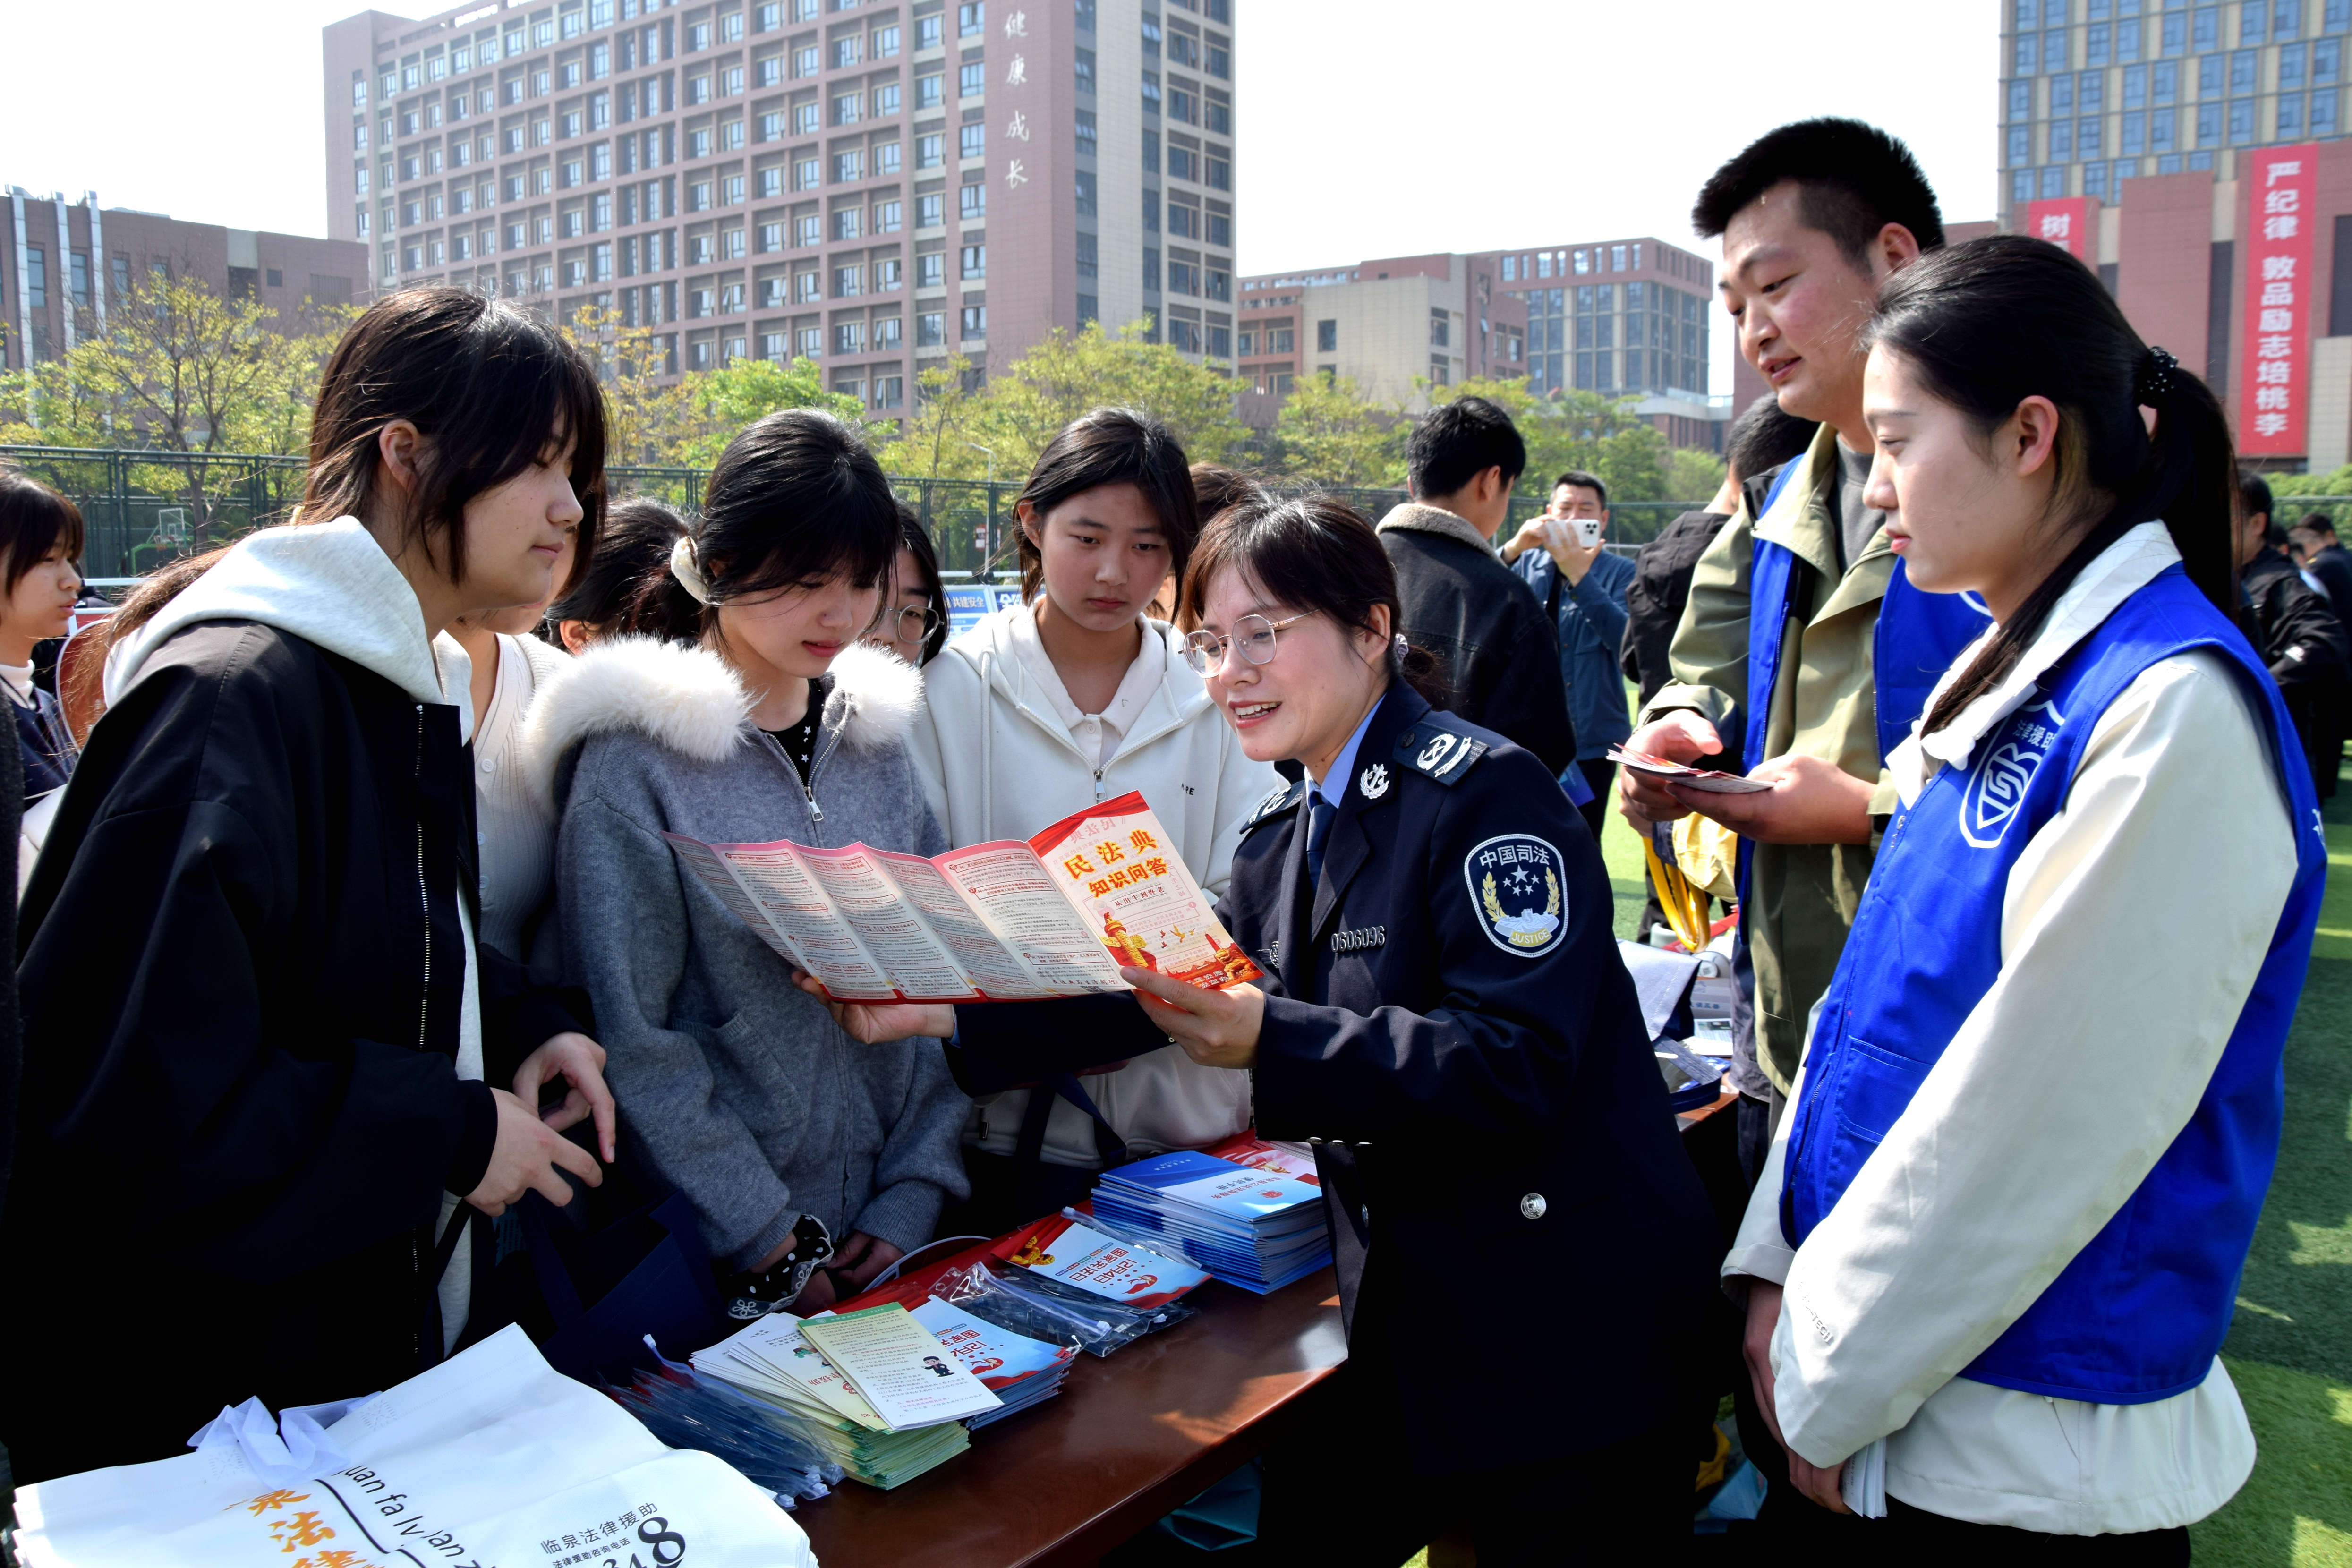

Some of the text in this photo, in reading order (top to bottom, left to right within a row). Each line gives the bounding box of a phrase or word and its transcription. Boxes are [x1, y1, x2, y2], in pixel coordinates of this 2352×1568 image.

[1004, 9, 1030, 189] 健康成长
[2254, 161, 2302, 437] 严纪律 敦品励志培桃李
[953, 596, 985, 608] 共建安全
[1063, 829, 1158, 880] 民法典
[1479, 844, 1550, 869] 中国司法
[1088, 857, 1168, 898] 知识问答
[1331, 926, 1385, 953] 0606096
[1512, 929, 1550, 944] JUSTICE
[1069, 1247, 1129, 1281] 国家宪法日
[1093, 1258, 1138, 1284] 12月4日
[331, 1465, 386, 1493] uan
[374, 1493, 408, 1517] fa
[393, 1515, 425, 1535] lv
[540, 1502, 658, 1555] 临泉法律援助
[552, 1537, 631, 1568] 法律援助咨询电话
